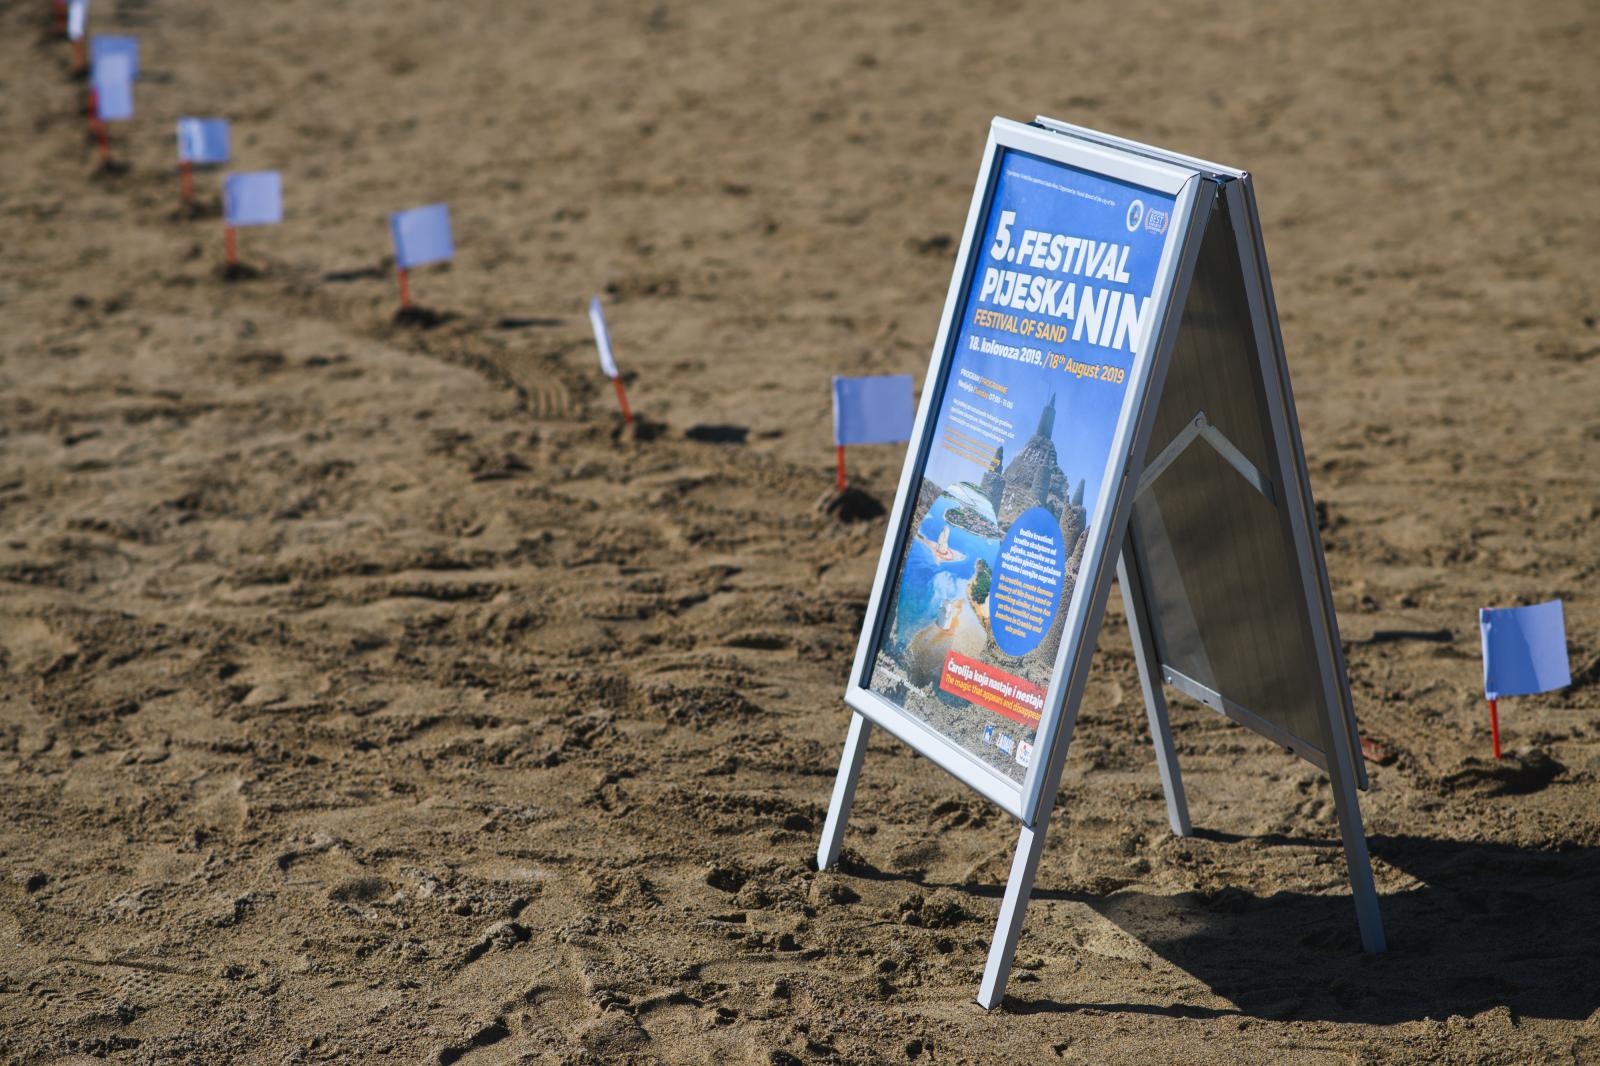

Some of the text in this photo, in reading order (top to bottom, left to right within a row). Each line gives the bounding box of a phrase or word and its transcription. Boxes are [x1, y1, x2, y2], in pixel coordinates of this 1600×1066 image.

[990, 211, 1130, 283] 5. FESTIVAL
[973, 309, 1068, 346] FESTIVAL OF SAND
[980, 268, 1151, 353] PIJESKA NIN
[968, 335, 982, 352] 18.
[980, 337, 1021, 362] kolovoza
[1019, 347, 1045, 367] 2019.
[1065, 357, 1101, 380] August
[1100, 365, 1126, 387] 2019
[945, 673, 954, 685] The
[955, 678, 972, 693] magic
[972, 685, 984, 697] that
[983, 691, 1003, 707] appears
[1003, 700, 1013, 710] and
[947, 657, 974, 683] Čarolija
[973, 670, 990, 689] koja
[988, 679, 1014, 697] nastaje
[1012, 686, 1017, 698] i
[1016, 689, 1044, 710] nestaje
